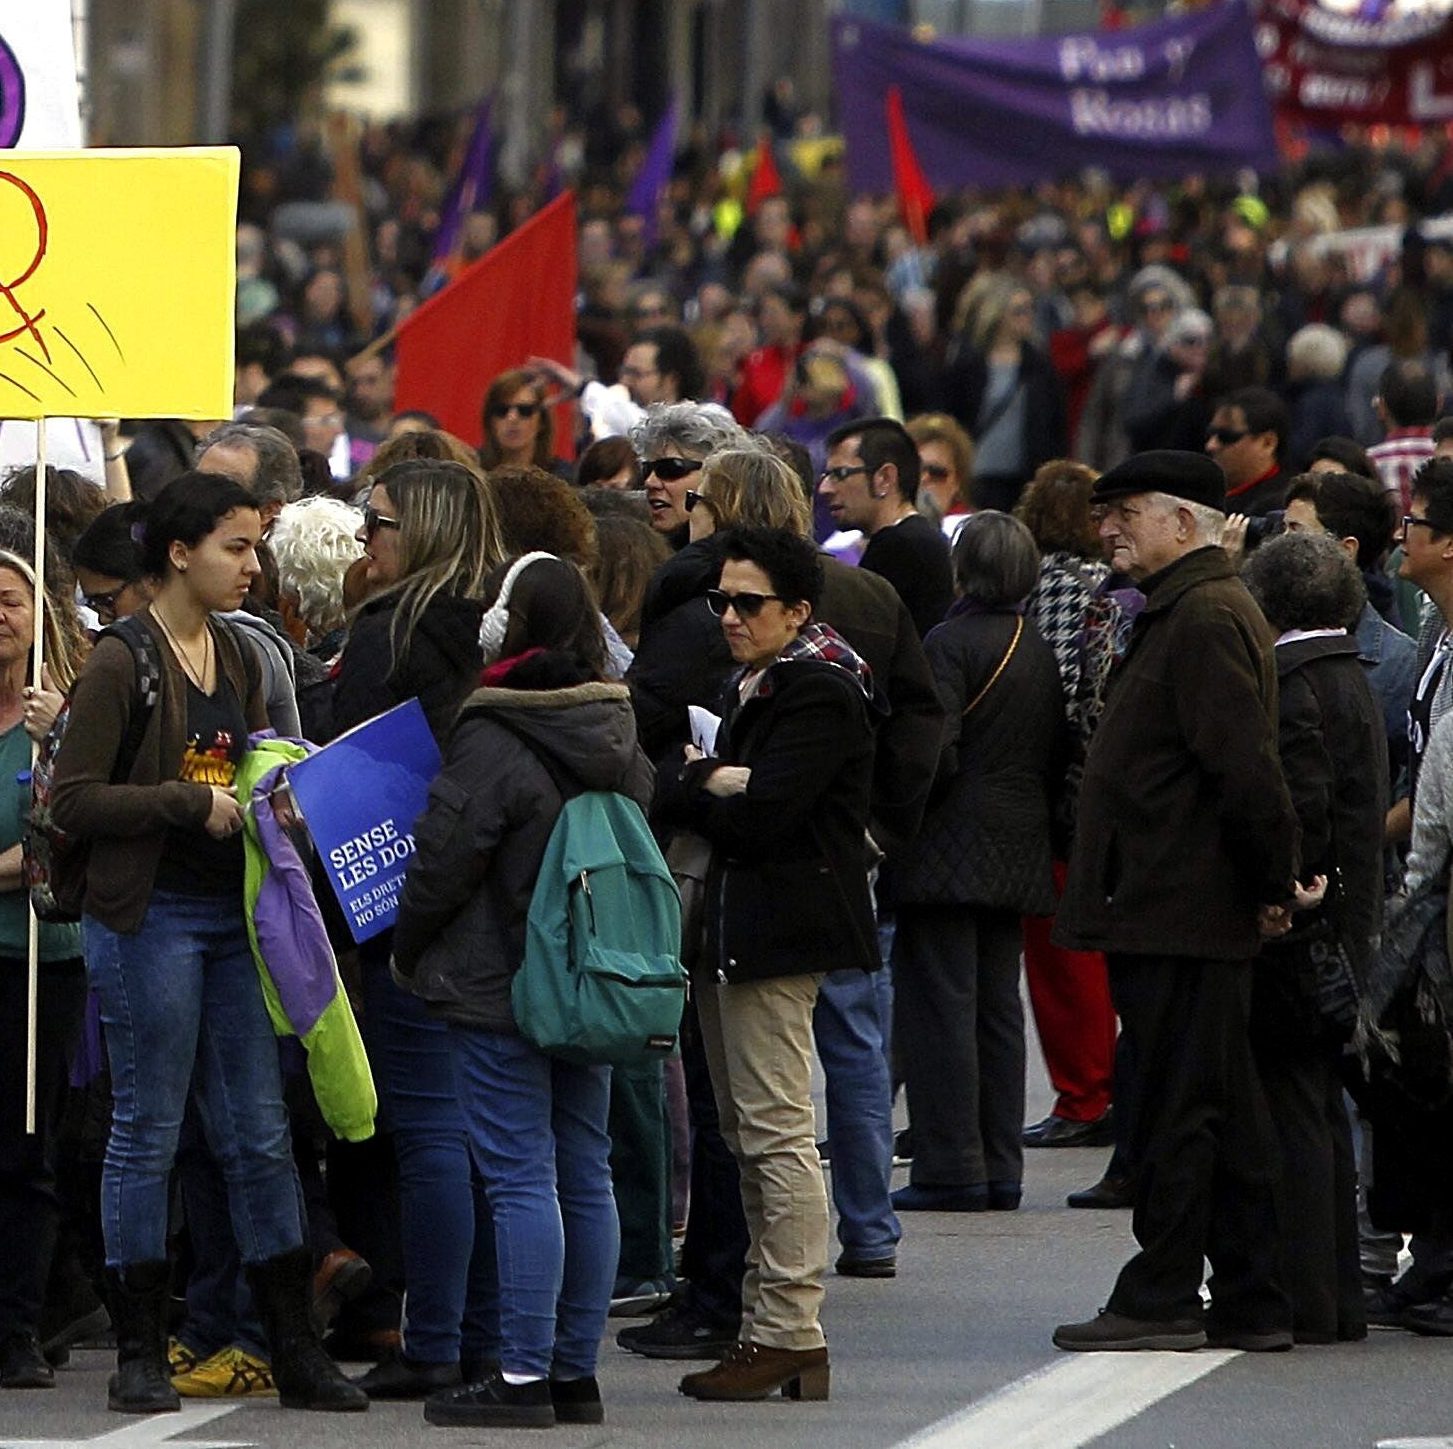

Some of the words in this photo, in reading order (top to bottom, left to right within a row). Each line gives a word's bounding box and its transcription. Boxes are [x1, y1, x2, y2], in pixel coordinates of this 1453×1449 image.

[329, 818, 399, 870] SENSE
[337, 855, 378, 892] LES
[349, 893, 373, 914] ELS
[355, 908, 374, 928] NO
